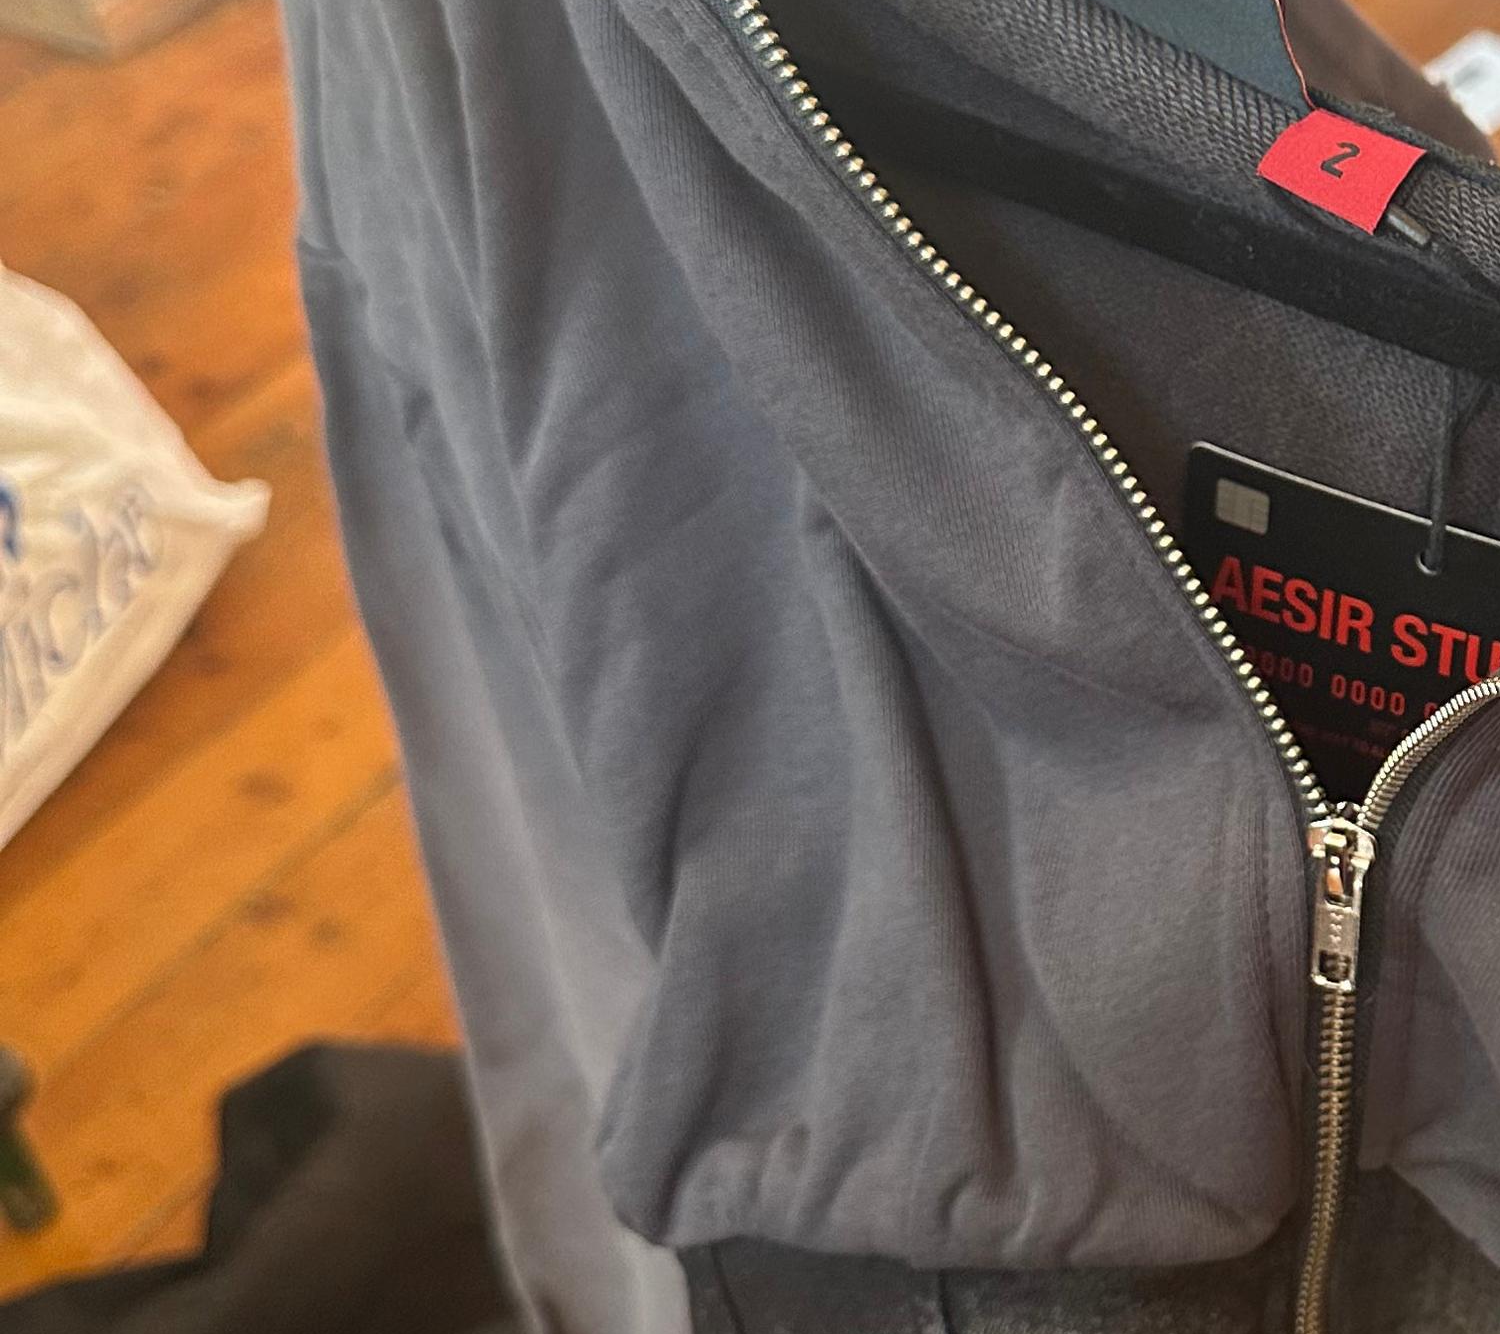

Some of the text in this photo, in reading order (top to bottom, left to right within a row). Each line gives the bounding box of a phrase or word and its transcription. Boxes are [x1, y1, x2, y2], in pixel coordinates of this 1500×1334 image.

[1320, 141, 1360, 179] 2
[1211, 555, 1375, 653] AESIR
[1331, 674, 1405, 716] 0000
